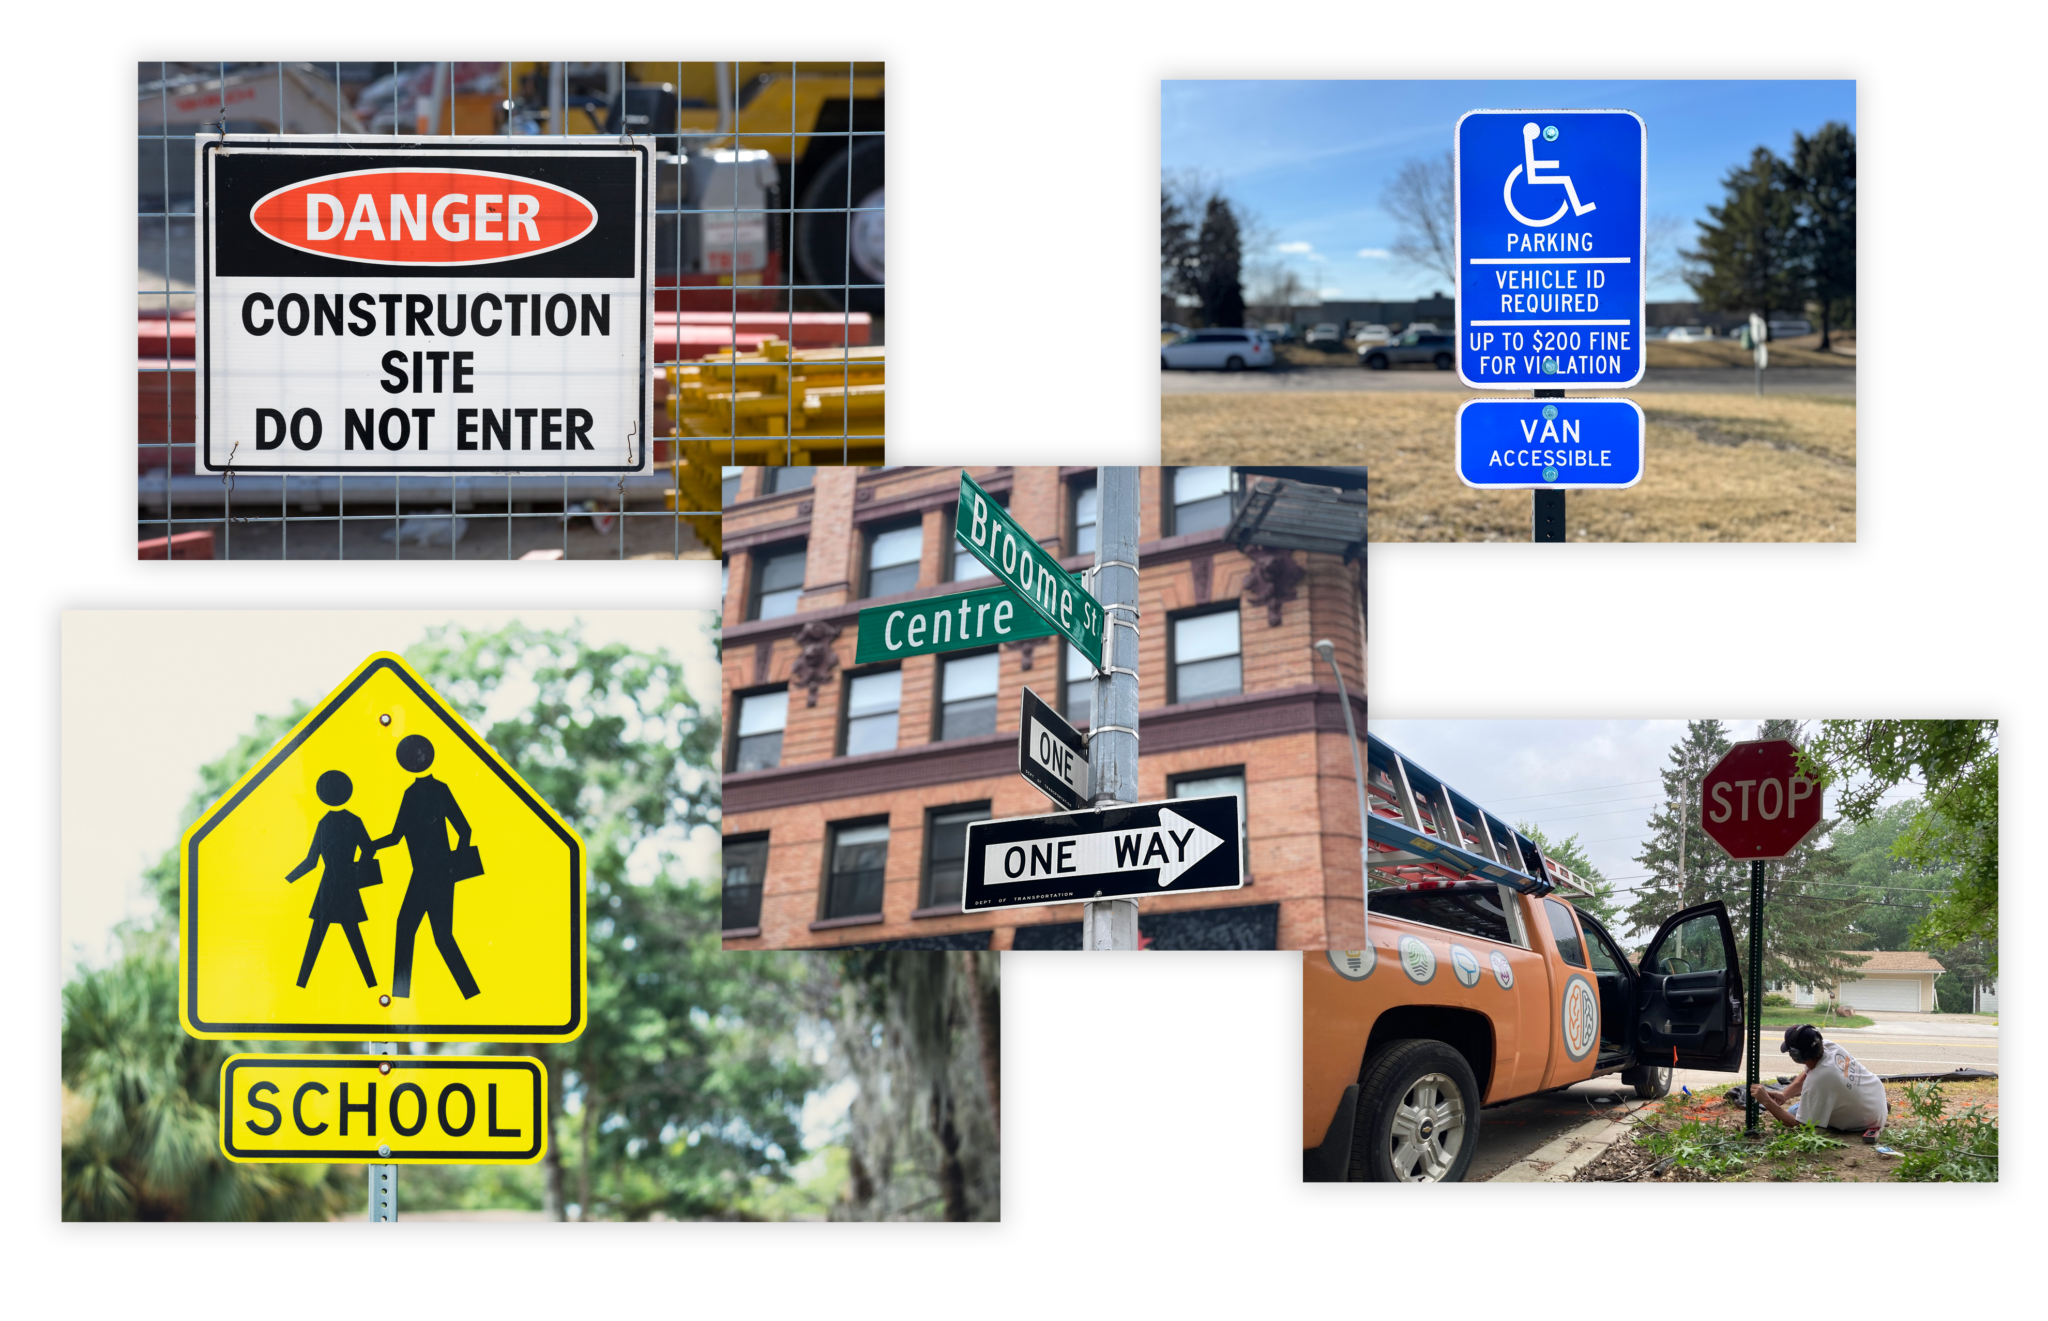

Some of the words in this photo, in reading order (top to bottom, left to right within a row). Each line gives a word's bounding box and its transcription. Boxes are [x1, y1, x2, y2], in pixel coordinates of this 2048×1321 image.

[306, 193, 541, 241] DANGER
[1507, 232, 1593, 252] PARKING
[1495, 270, 1577, 289] VEHICLE
[1586, 270, 1605, 289] ID
[241, 292, 610, 336] CONSTRUCTION
[1501, 294, 1599, 313] REQUIRED
[1470, 332, 1494, 351] UP
[1502, 332, 1524, 350] TO
[1532, 329, 1581, 353] $200
[1590, 332, 1631, 350] FINE
[380, 350, 474, 394] SITE
[1480, 356, 1516, 374] FOR
[255, 407, 323, 451] DO
[344, 407, 435, 451] NOT
[457, 408, 595, 450] ENTER
[1520, 419, 1580, 443] VAN
[1488, 450, 1612, 467] ACCESSIBLE
[970, 492, 1074, 629] Broome
[1083, 601, 1097, 637] St
[884, 599, 1014, 651] Centre
[1039, 731, 1074, 787] ONE
[1708, 777, 1814, 823] STOP
[1004, 840, 1076, 879] ONE
[1114, 828, 1195, 868] WAY
[1013, 891, 1074, 902] TRANSPORTATION
[245, 1081, 521, 1137] SCHOOL
